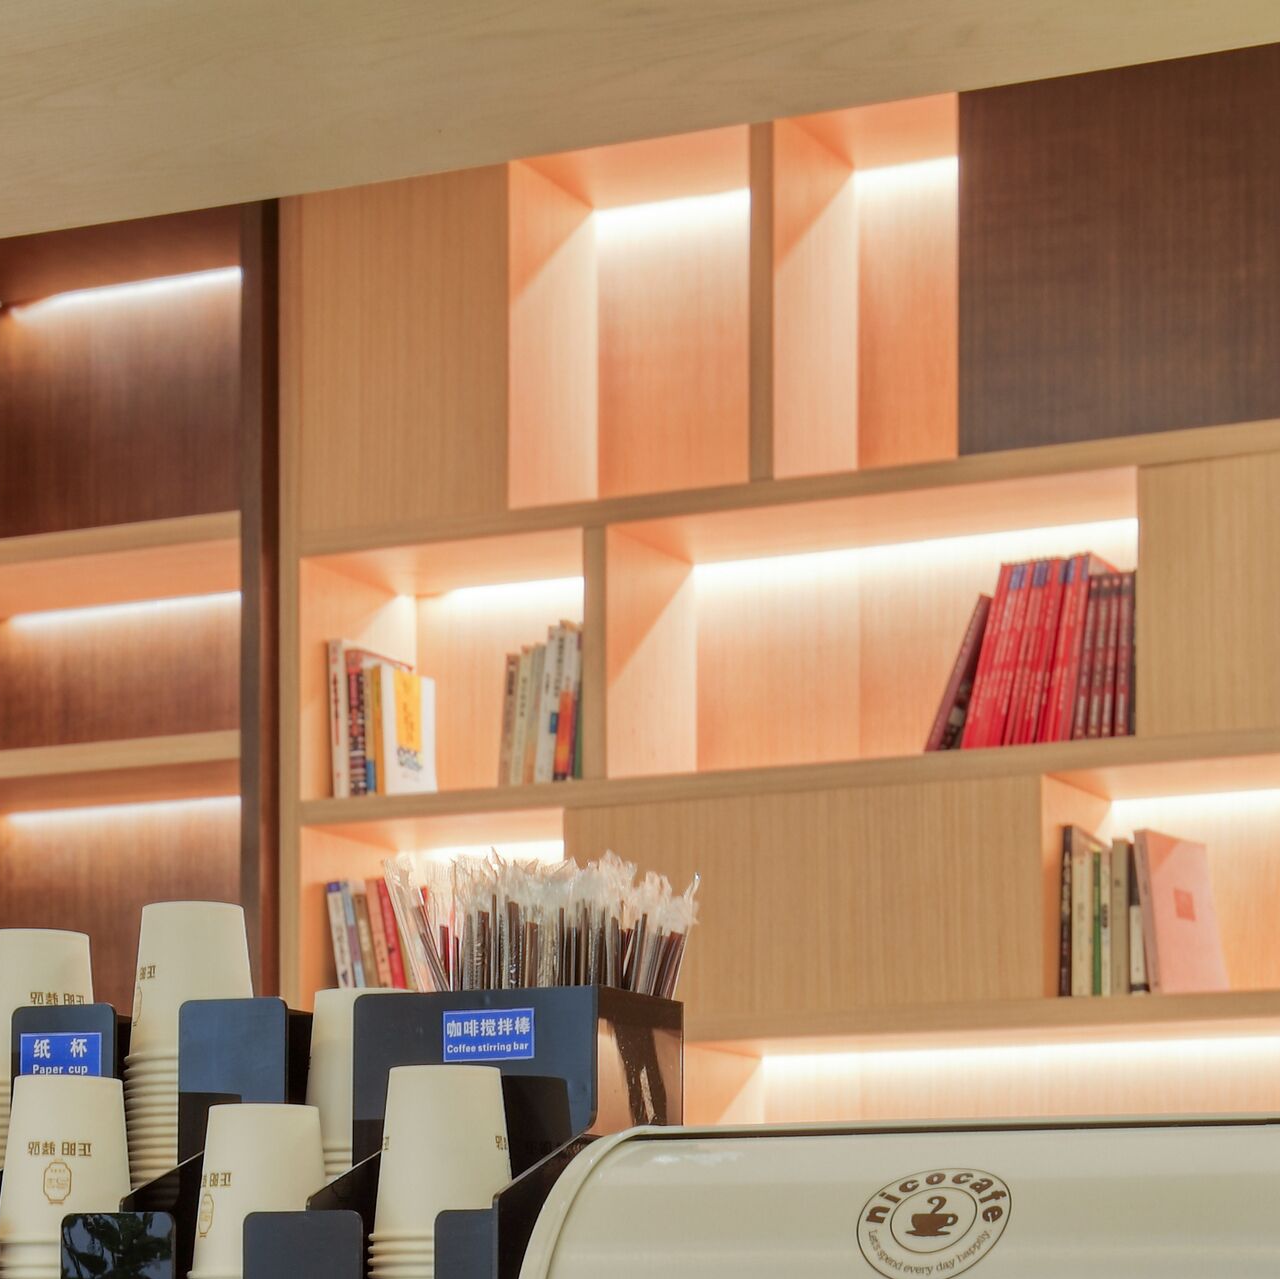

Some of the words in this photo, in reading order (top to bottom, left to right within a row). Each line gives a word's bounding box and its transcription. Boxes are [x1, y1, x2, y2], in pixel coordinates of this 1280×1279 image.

[446, 1016, 531, 1038] 咖啡搅拌棒
[33, 1038, 87, 1059] 纸杯
[447, 1043, 476, 1054] Coffee
[477, 1042, 512, 1052] stirring
[513, 1041, 529, 1050] bar
[32, 1064, 63, 1075] Paper
[68, 1065, 88, 1075] cup
[866, 1172, 1007, 1224] nicocafe
[903, 1263, 934, 1276] every
[936, 1259, 956, 1274] day
